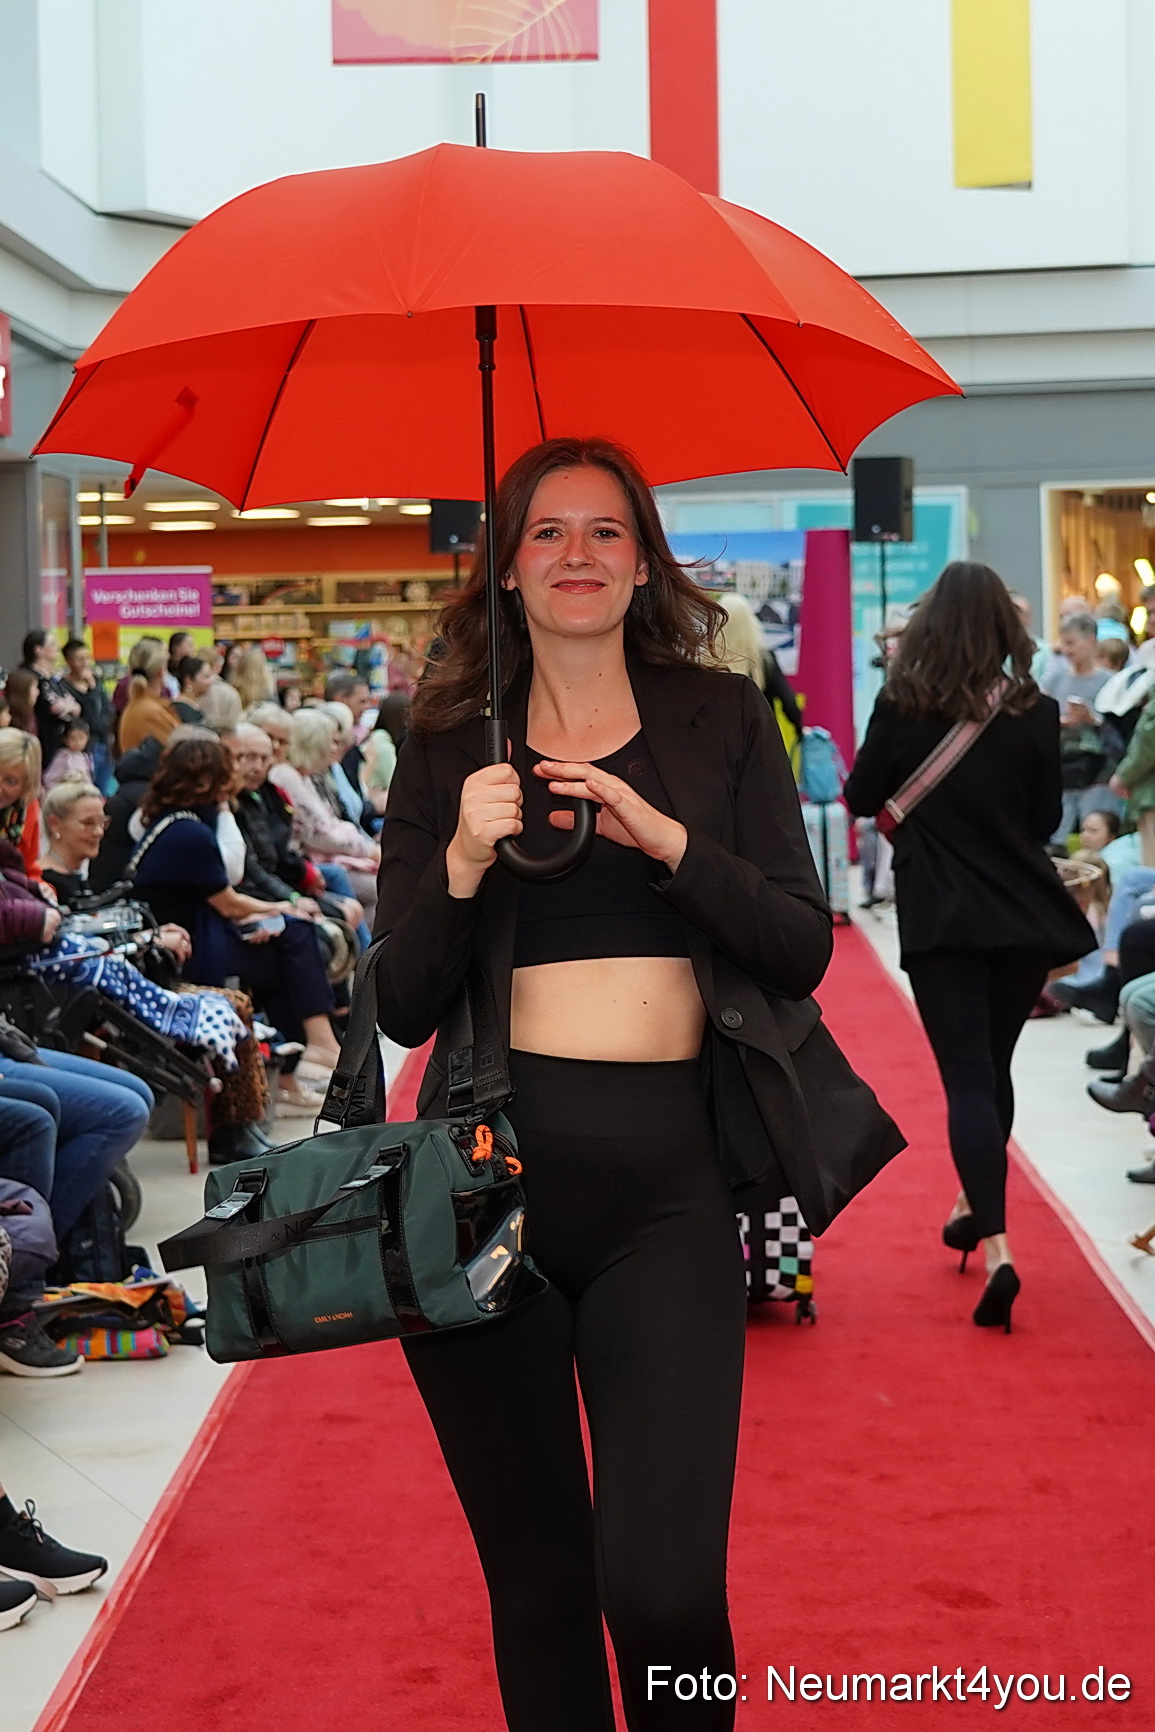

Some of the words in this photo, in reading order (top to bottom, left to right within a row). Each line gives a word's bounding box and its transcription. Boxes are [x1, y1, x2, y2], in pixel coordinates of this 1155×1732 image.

[92, 588, 177, 604] Verschenken
[178, 587, 200, 602] Sie
[119, 603, 200, 619] Gutscheine!
